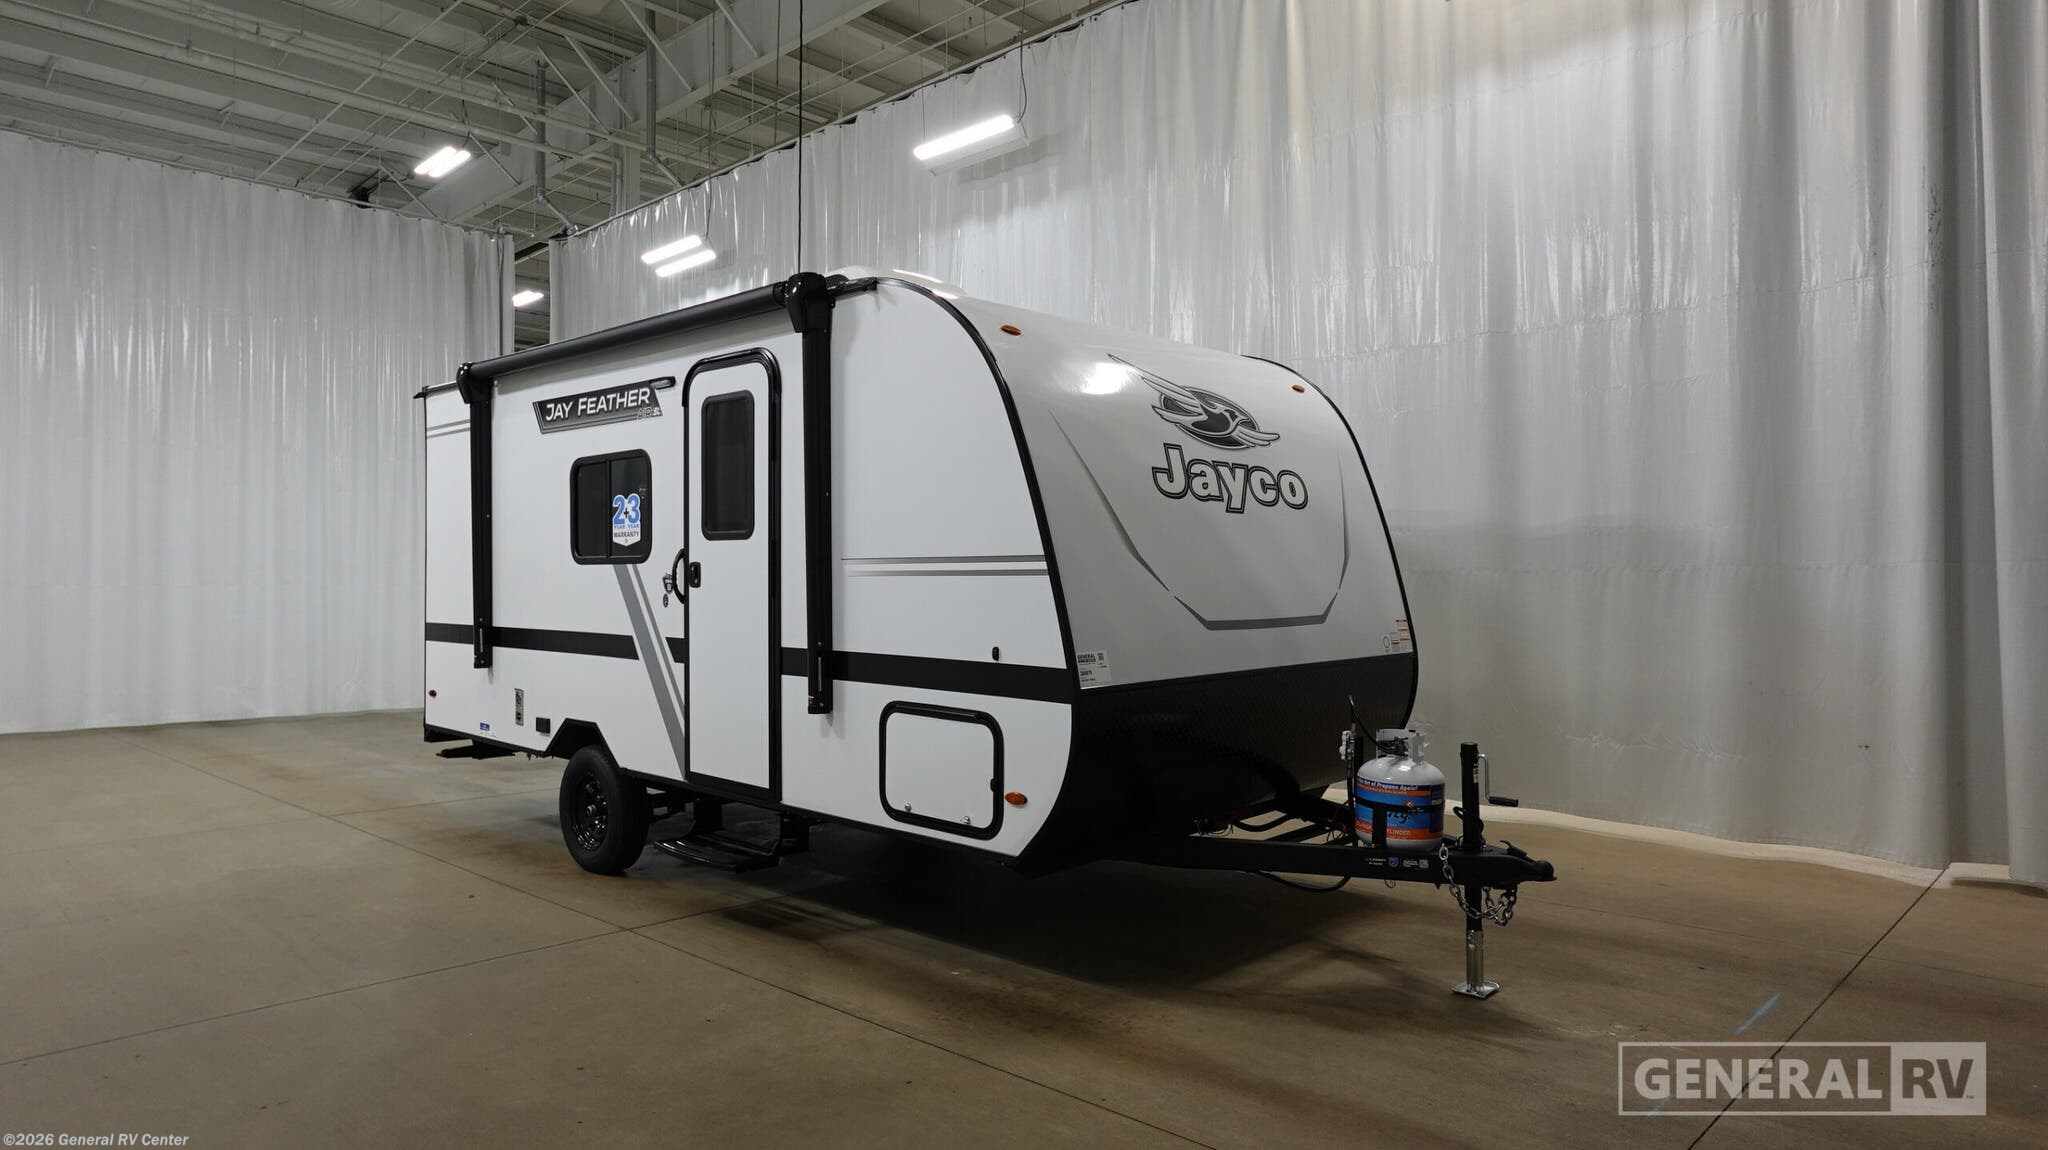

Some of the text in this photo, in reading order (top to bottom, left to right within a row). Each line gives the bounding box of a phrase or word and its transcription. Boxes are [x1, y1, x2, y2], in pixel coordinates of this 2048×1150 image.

[545, 387, 651, 421] JAY FEATHER
[1152, 442, 1309, 514] Jayco
